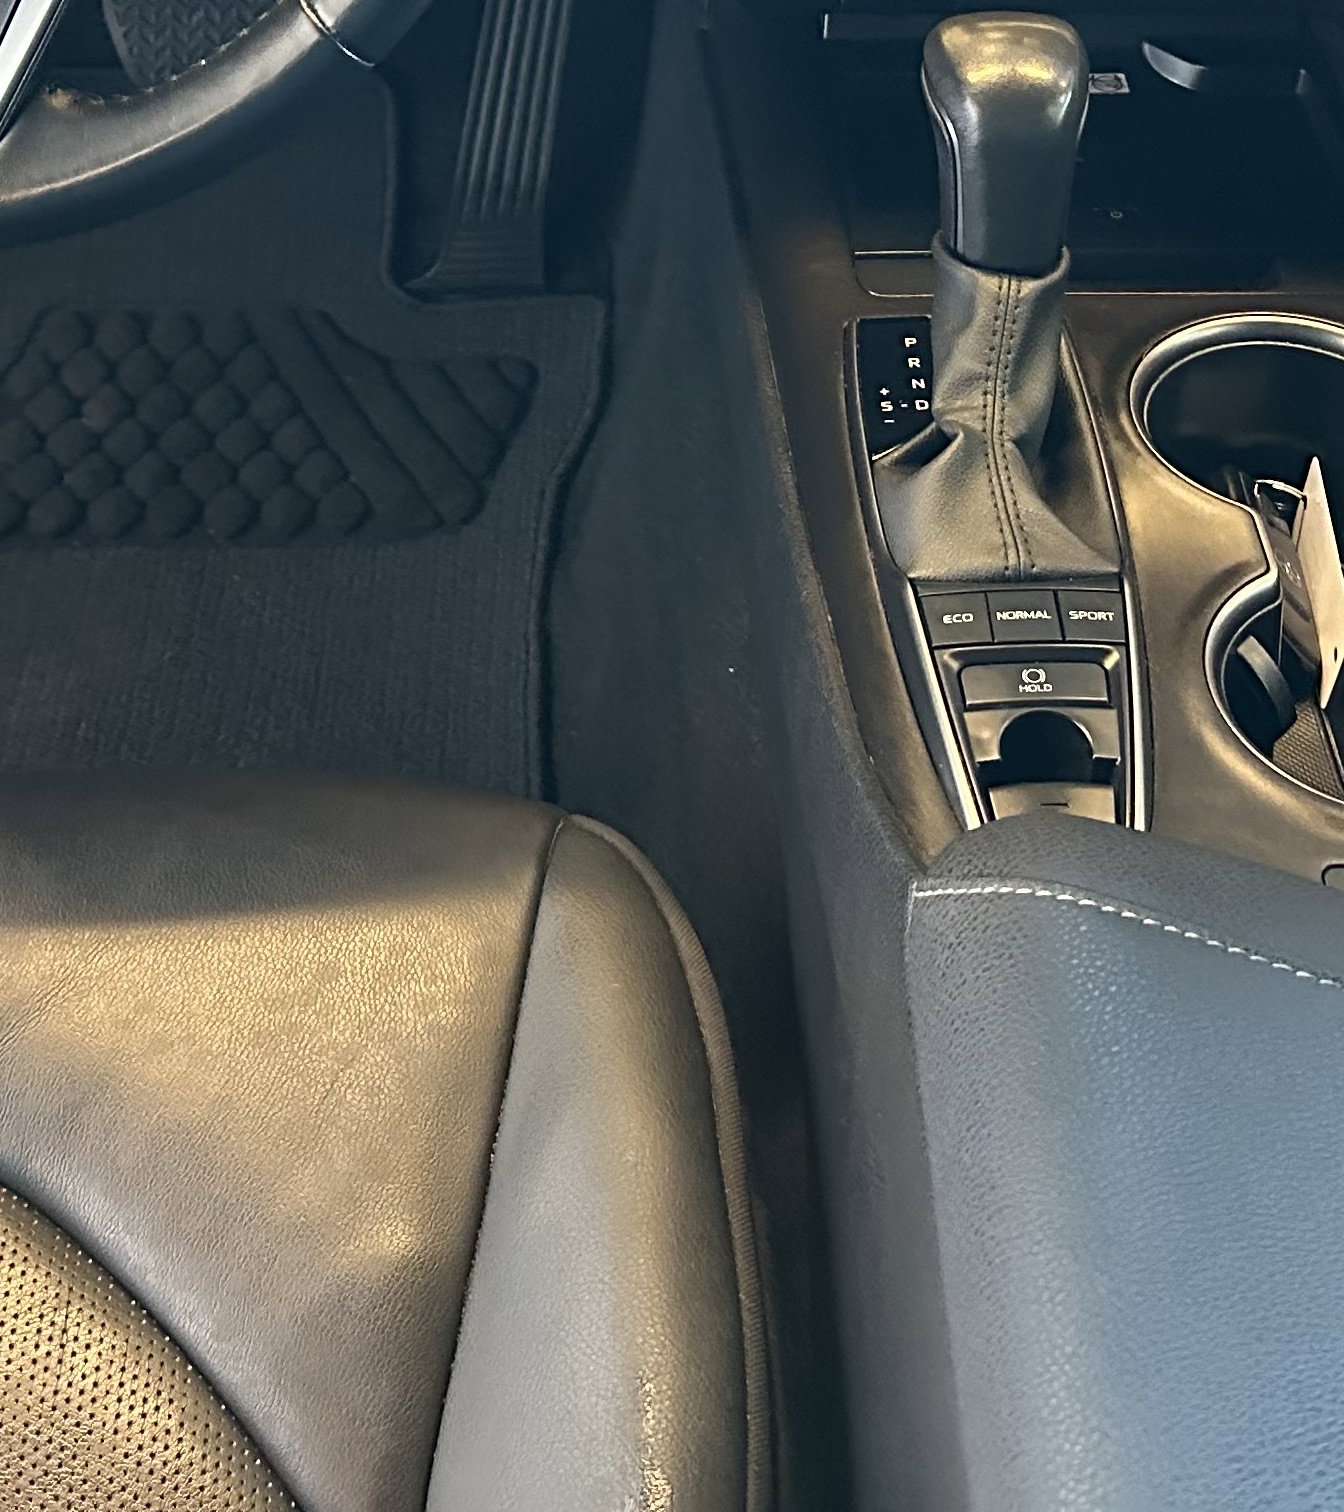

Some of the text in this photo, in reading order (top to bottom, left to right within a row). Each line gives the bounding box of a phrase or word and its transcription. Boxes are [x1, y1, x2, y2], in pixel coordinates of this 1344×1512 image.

[905, 337, 917, 348] P
[908, 358, 921, 368] R
[912, 379, 925, 389] N
[881, 400, 929, 412] S D
[942, 613, 974, 624] ECO
[995, 610, 1051, 621] NORMAL
[1068, 610, 1115, 622] SPORT
[1019, 684, 1053, 693] HOLD
